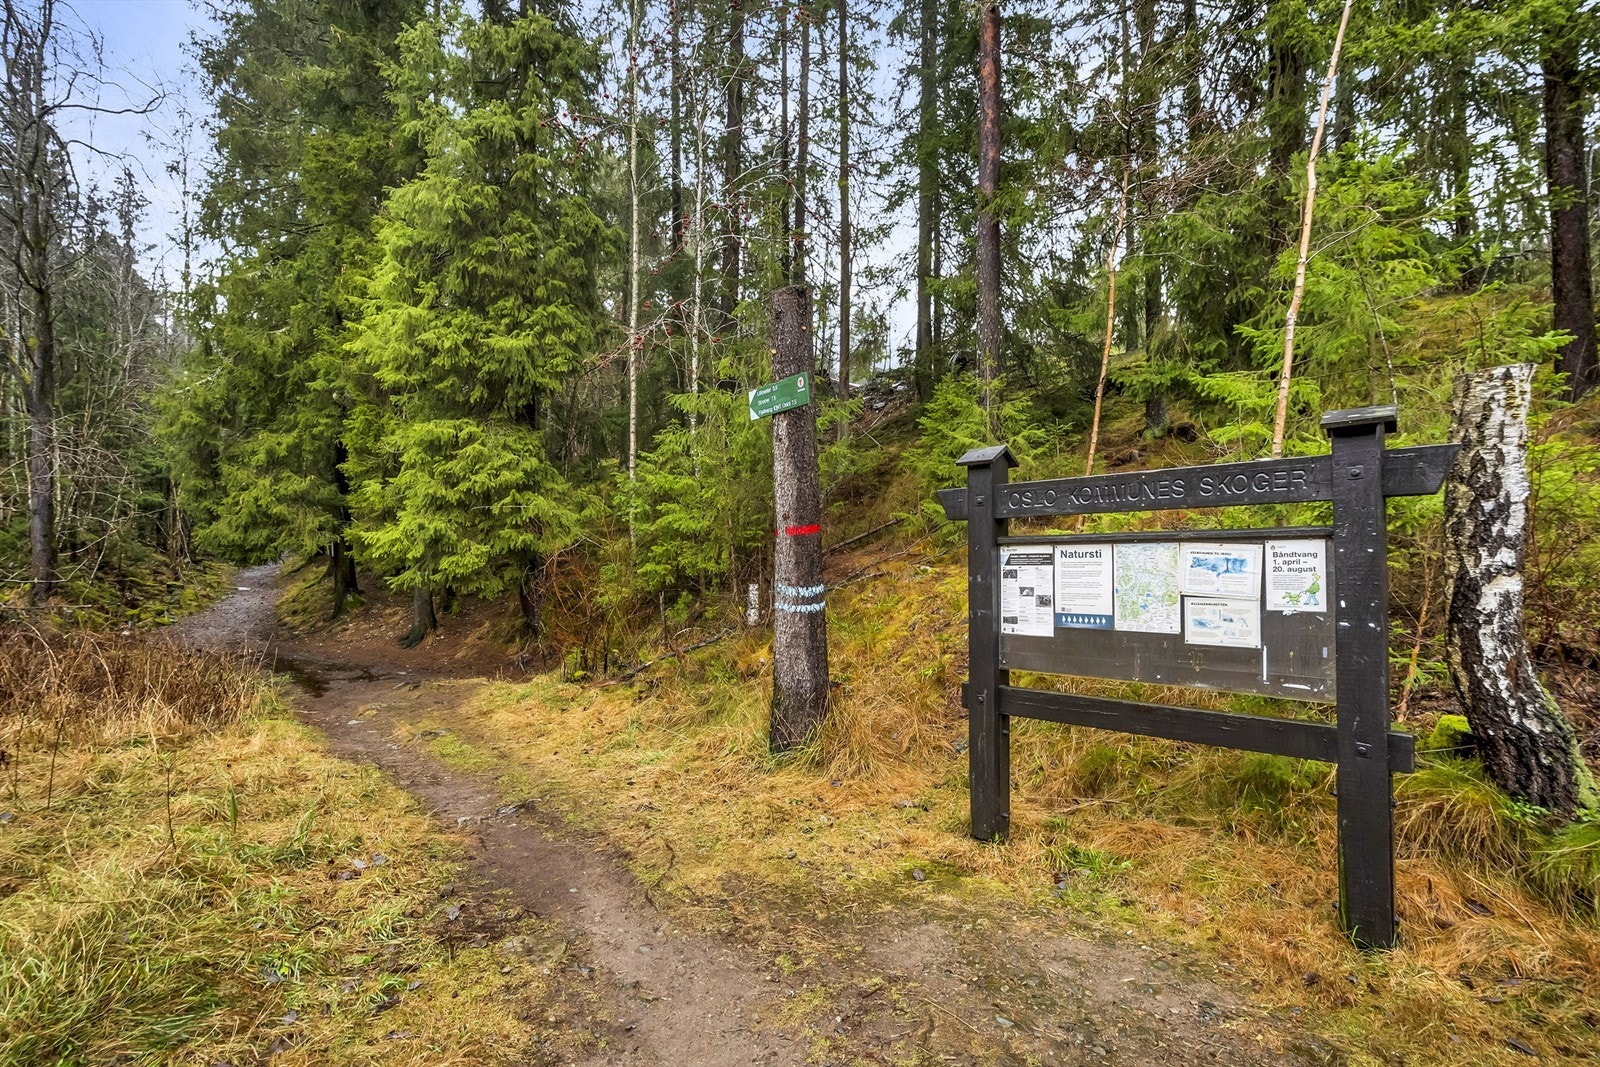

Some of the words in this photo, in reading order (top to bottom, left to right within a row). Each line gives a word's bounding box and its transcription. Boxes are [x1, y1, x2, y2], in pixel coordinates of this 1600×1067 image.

[1008, 489, 1057, 509] OSLO
[1067, 479, 1186, 505] KOMMUNES
[1200, 470, 1308, 496] SKOGER
[1060, 549, 1102, 559] Natursti
[1272, 551, 1318, 559] Båndtvang
[1287, 566, 1317, 574] august
